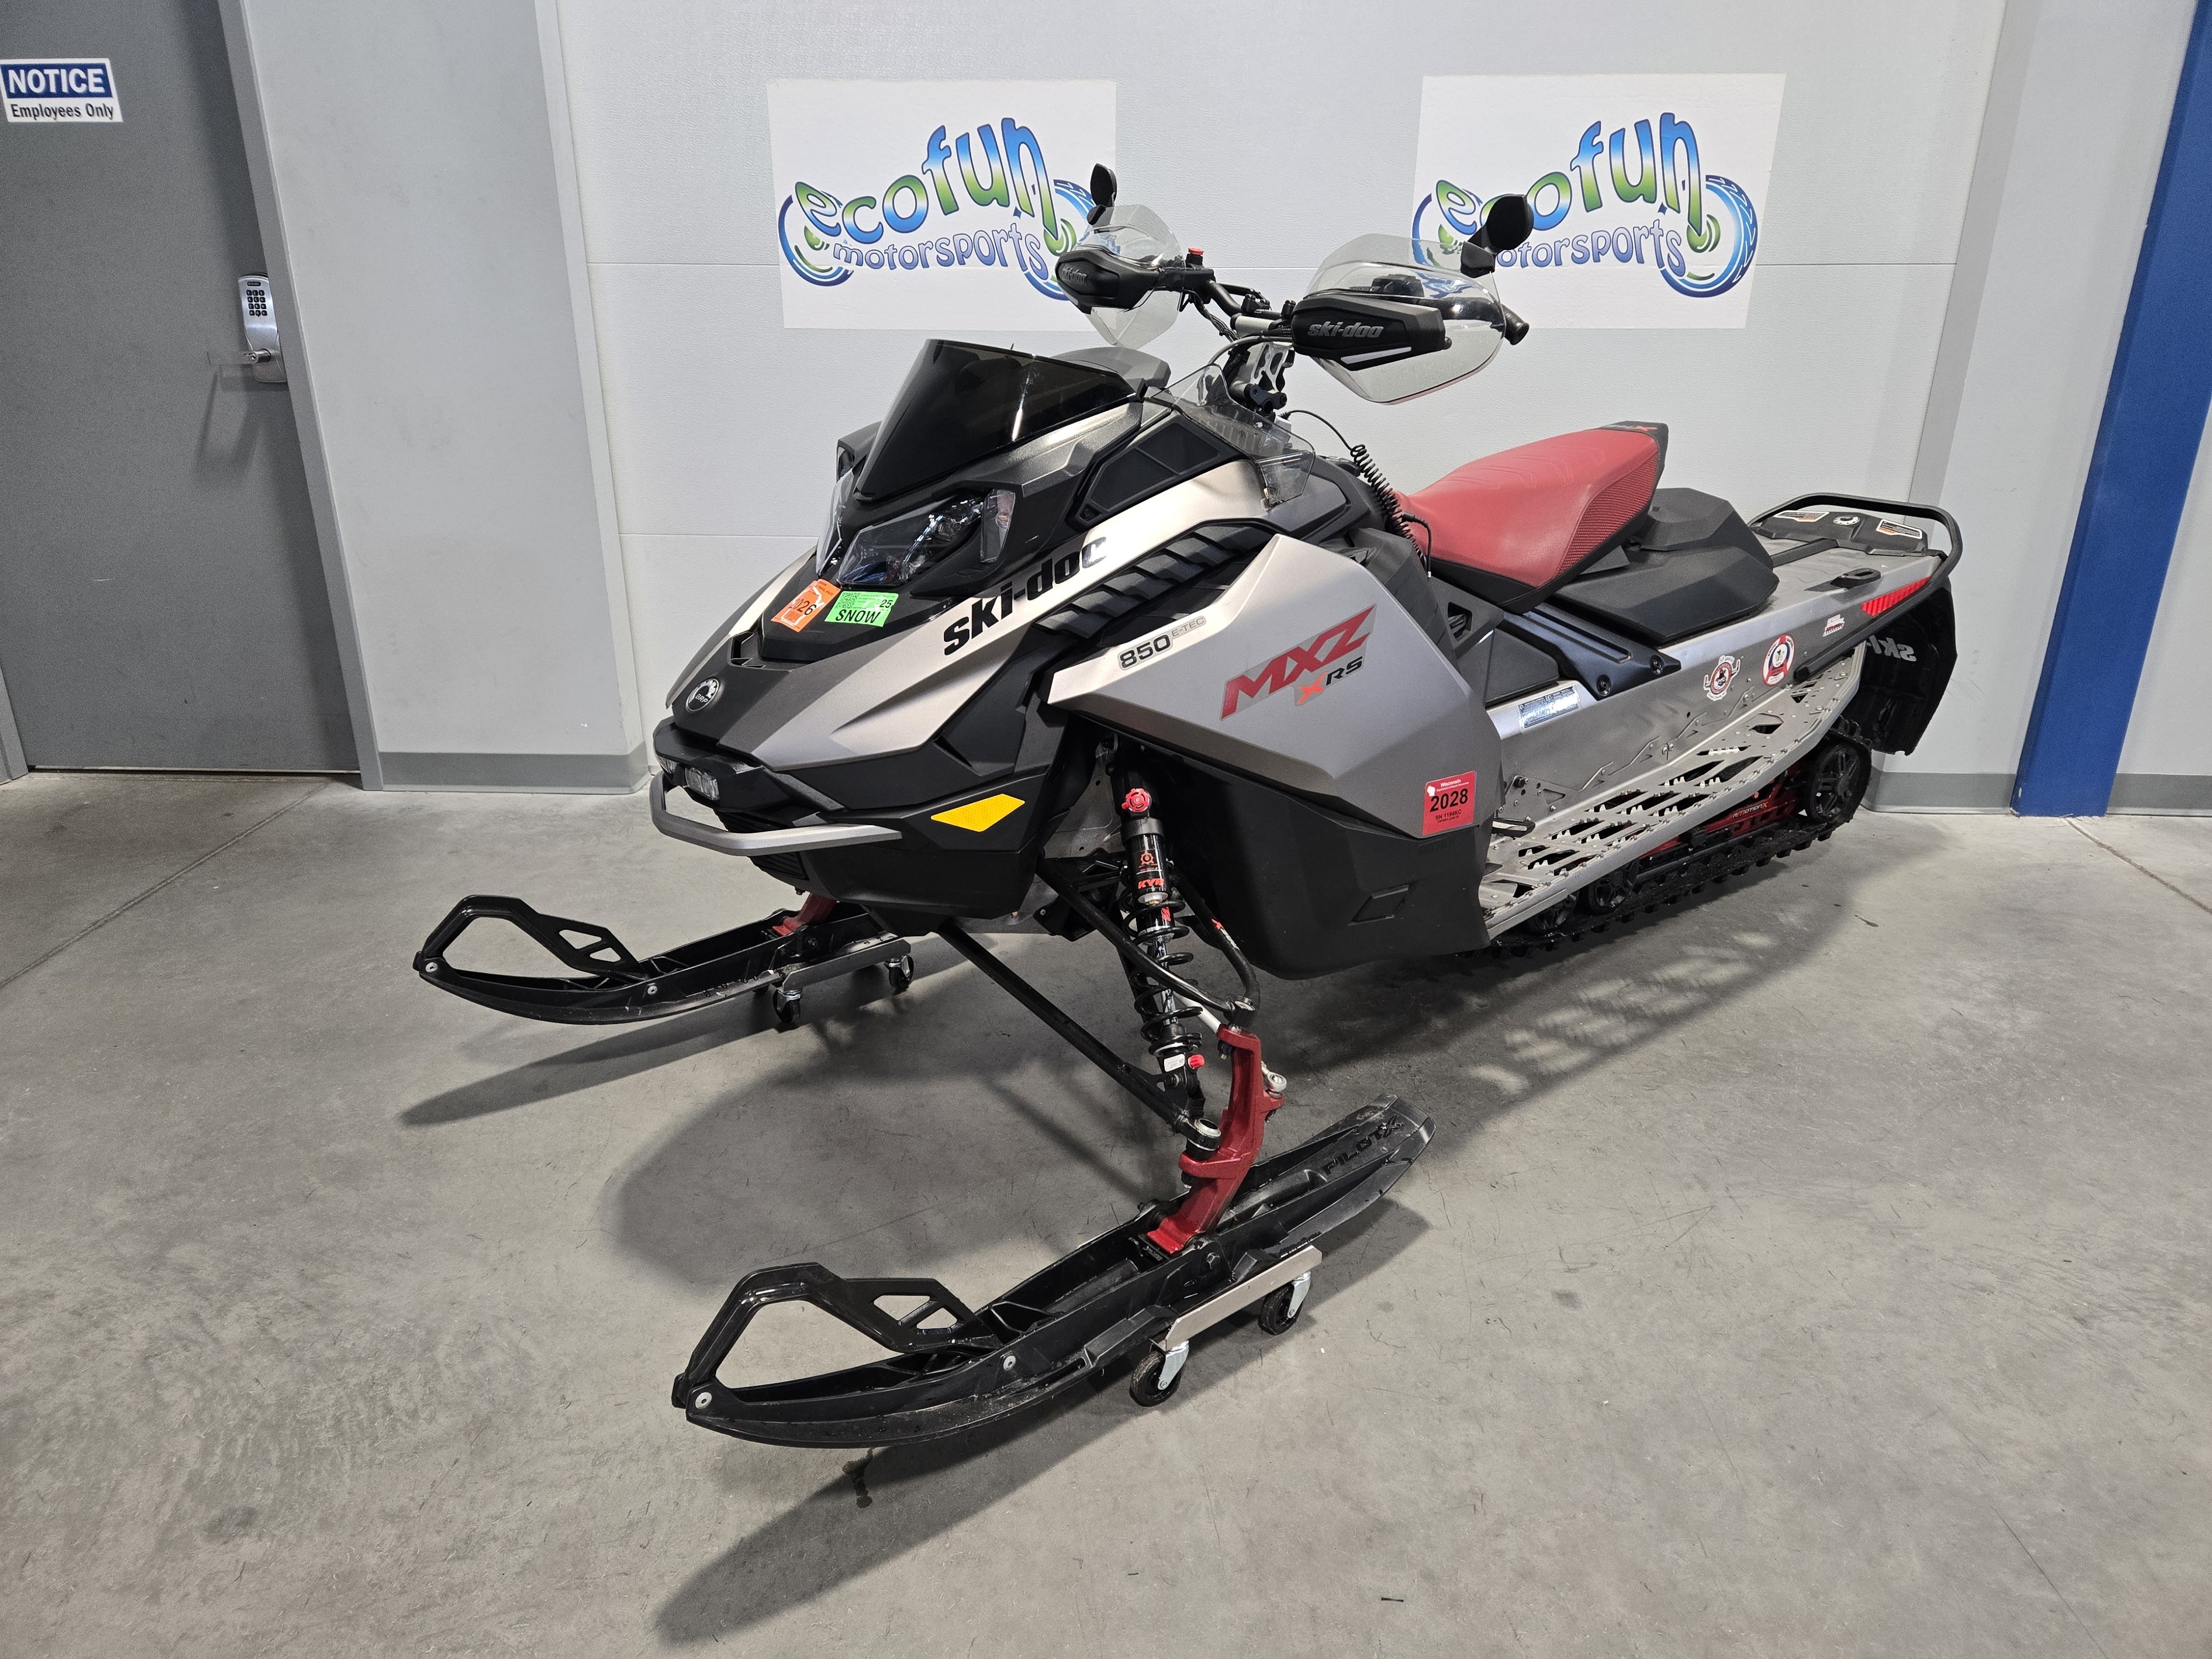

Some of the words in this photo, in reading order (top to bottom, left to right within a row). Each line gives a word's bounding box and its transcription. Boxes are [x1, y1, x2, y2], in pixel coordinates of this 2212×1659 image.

[8, 69, 105, 93] NOTICE
[10, 103, 81, 120] Employees
[85, 103, 113, 120] Only
[795, 117, 1058, 244] ecofun
[833, 223, 1049, 280] motorsports
[1496, 219, 1686, 277] otorsports
[1307, 321, 1384, 338] ski-doo
[879, 599, 894, 608] 25
[836, 609, 881, 623] SNOW
[1120, 634, 1171, 668] 850
[1171, 617, 1204, 637] E-TEC
[1221, 605, 1376, 719] MXZ
[695, 693, 708, 703] BRP
[1440, 779, 1462, 787] Wisconsin
[1430, 788, 1468, 812] 2028
